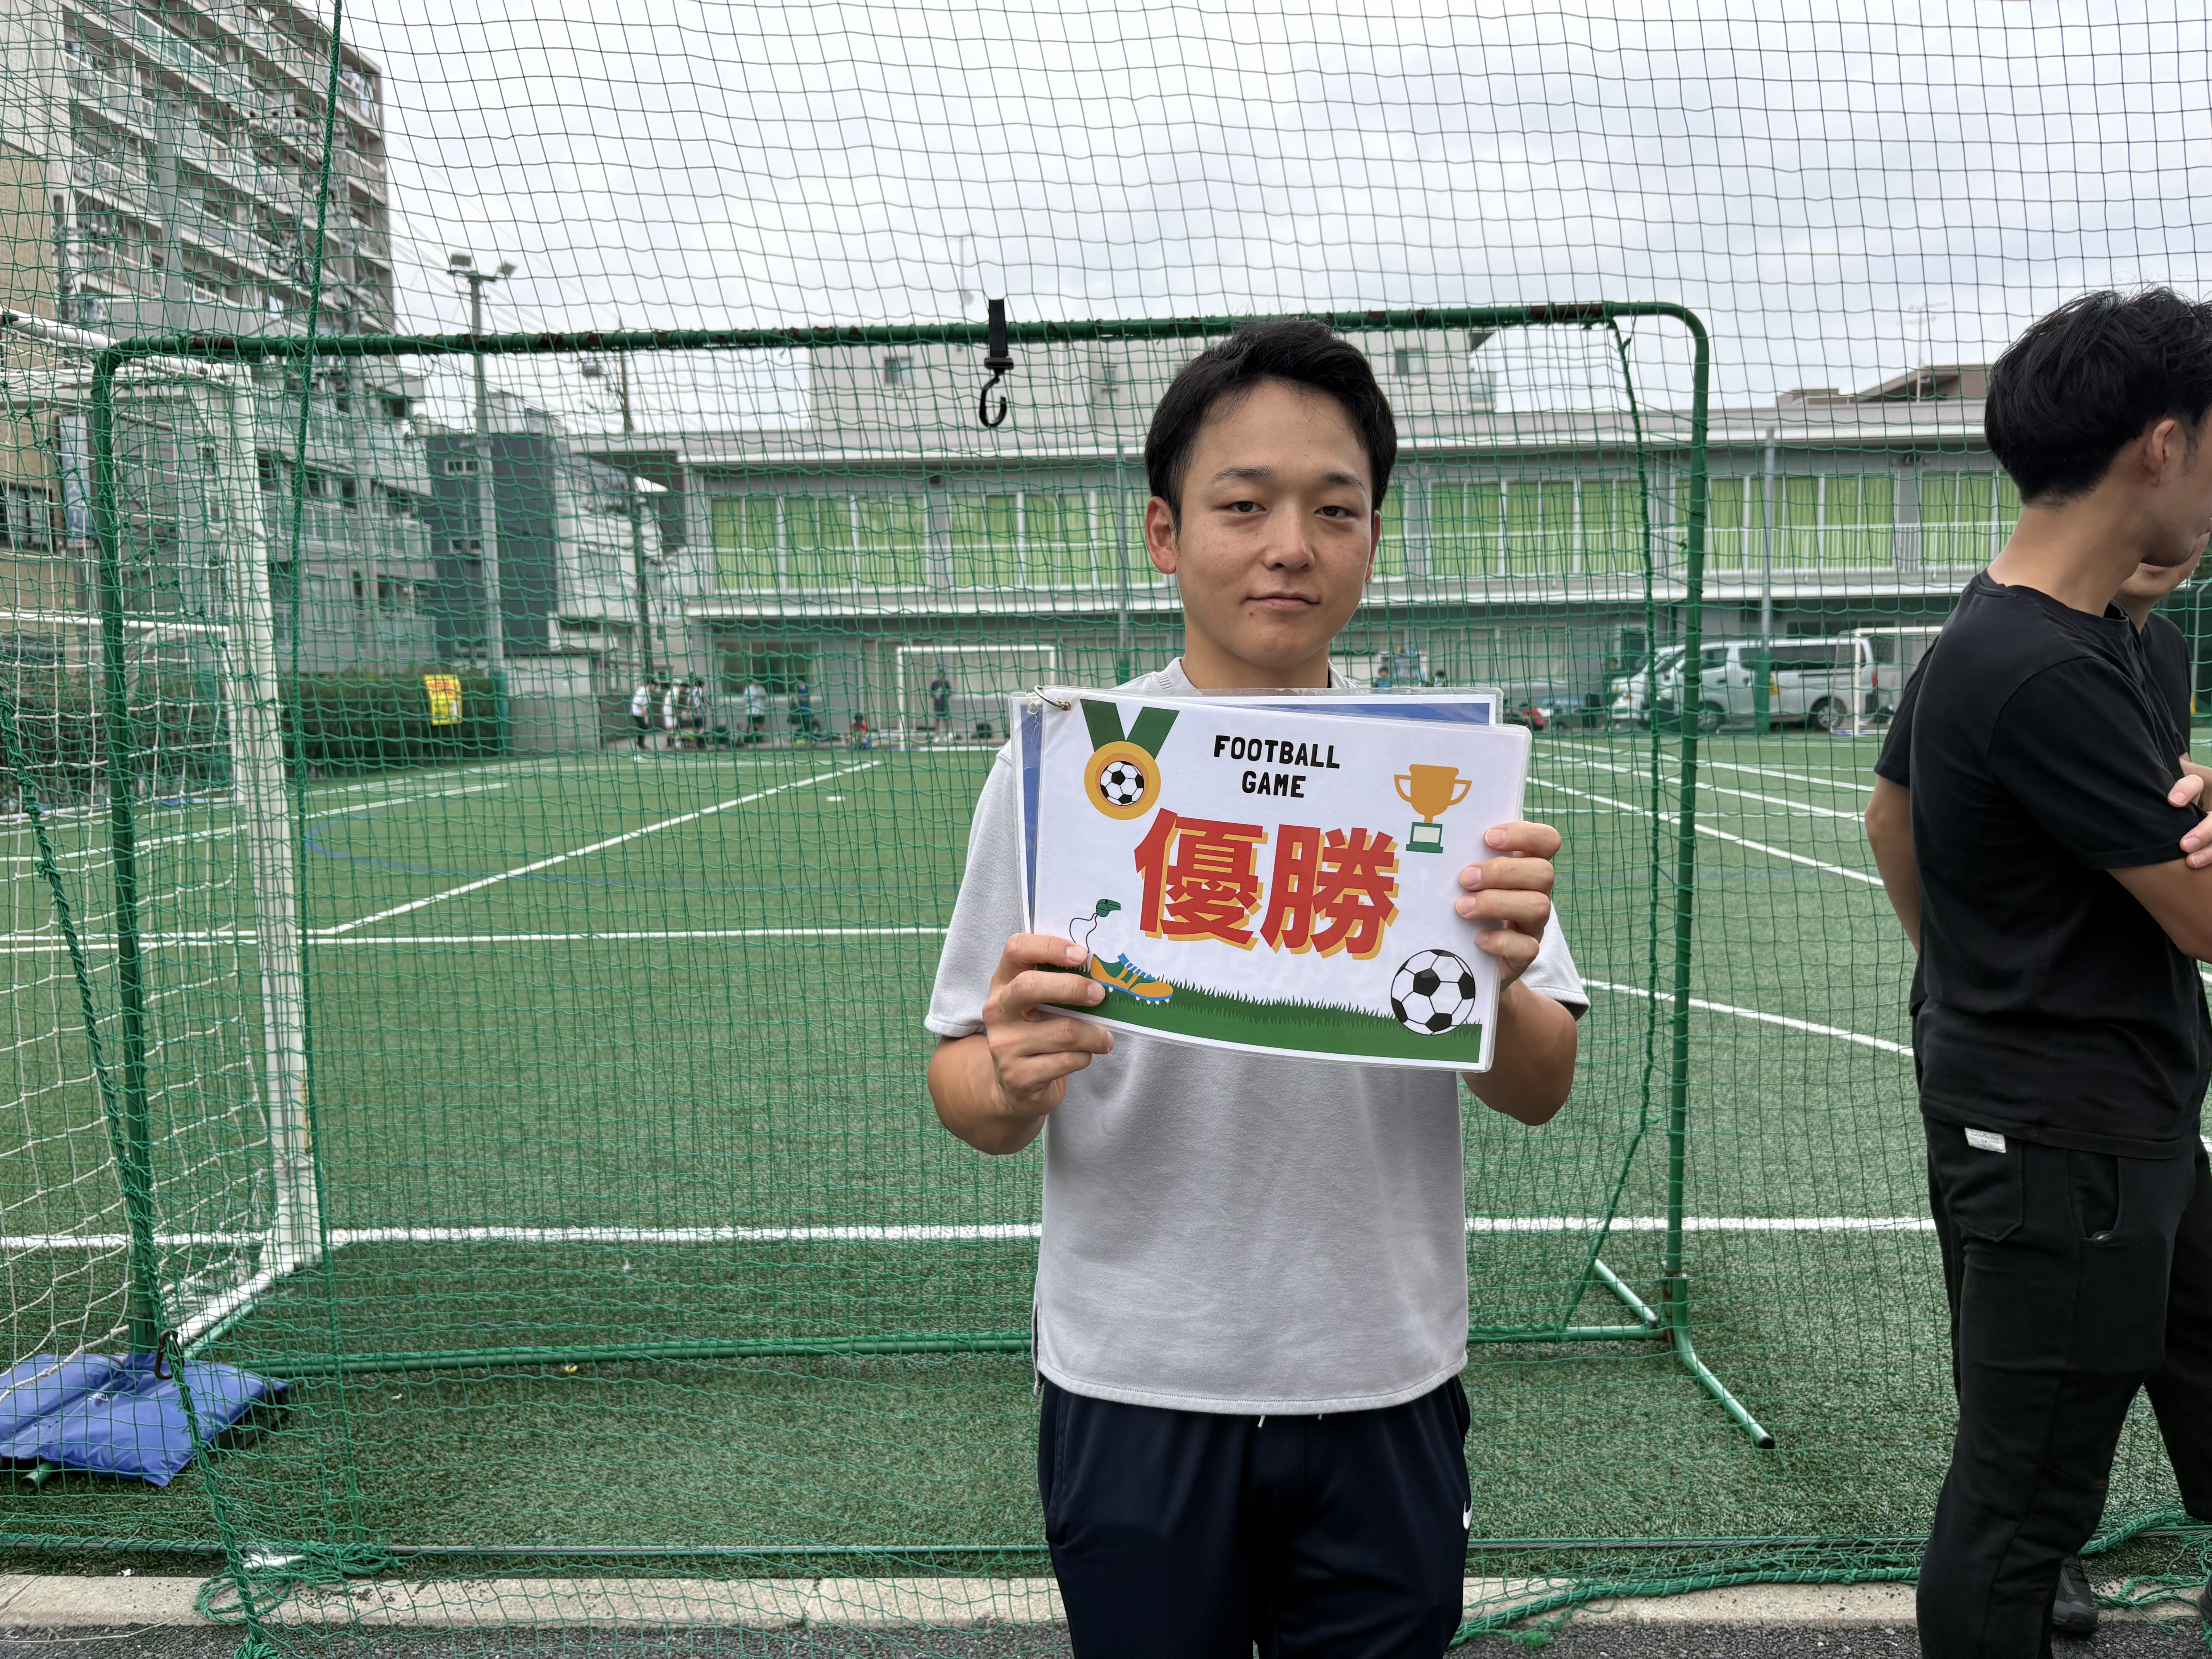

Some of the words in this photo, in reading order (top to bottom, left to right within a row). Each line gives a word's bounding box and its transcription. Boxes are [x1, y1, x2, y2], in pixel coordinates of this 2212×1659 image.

[1214, 735, 1340, 769] FOOTBALL
[1242, 771, 1306, 798] GAME
[1134, 808, 1399, 960] 優勝
